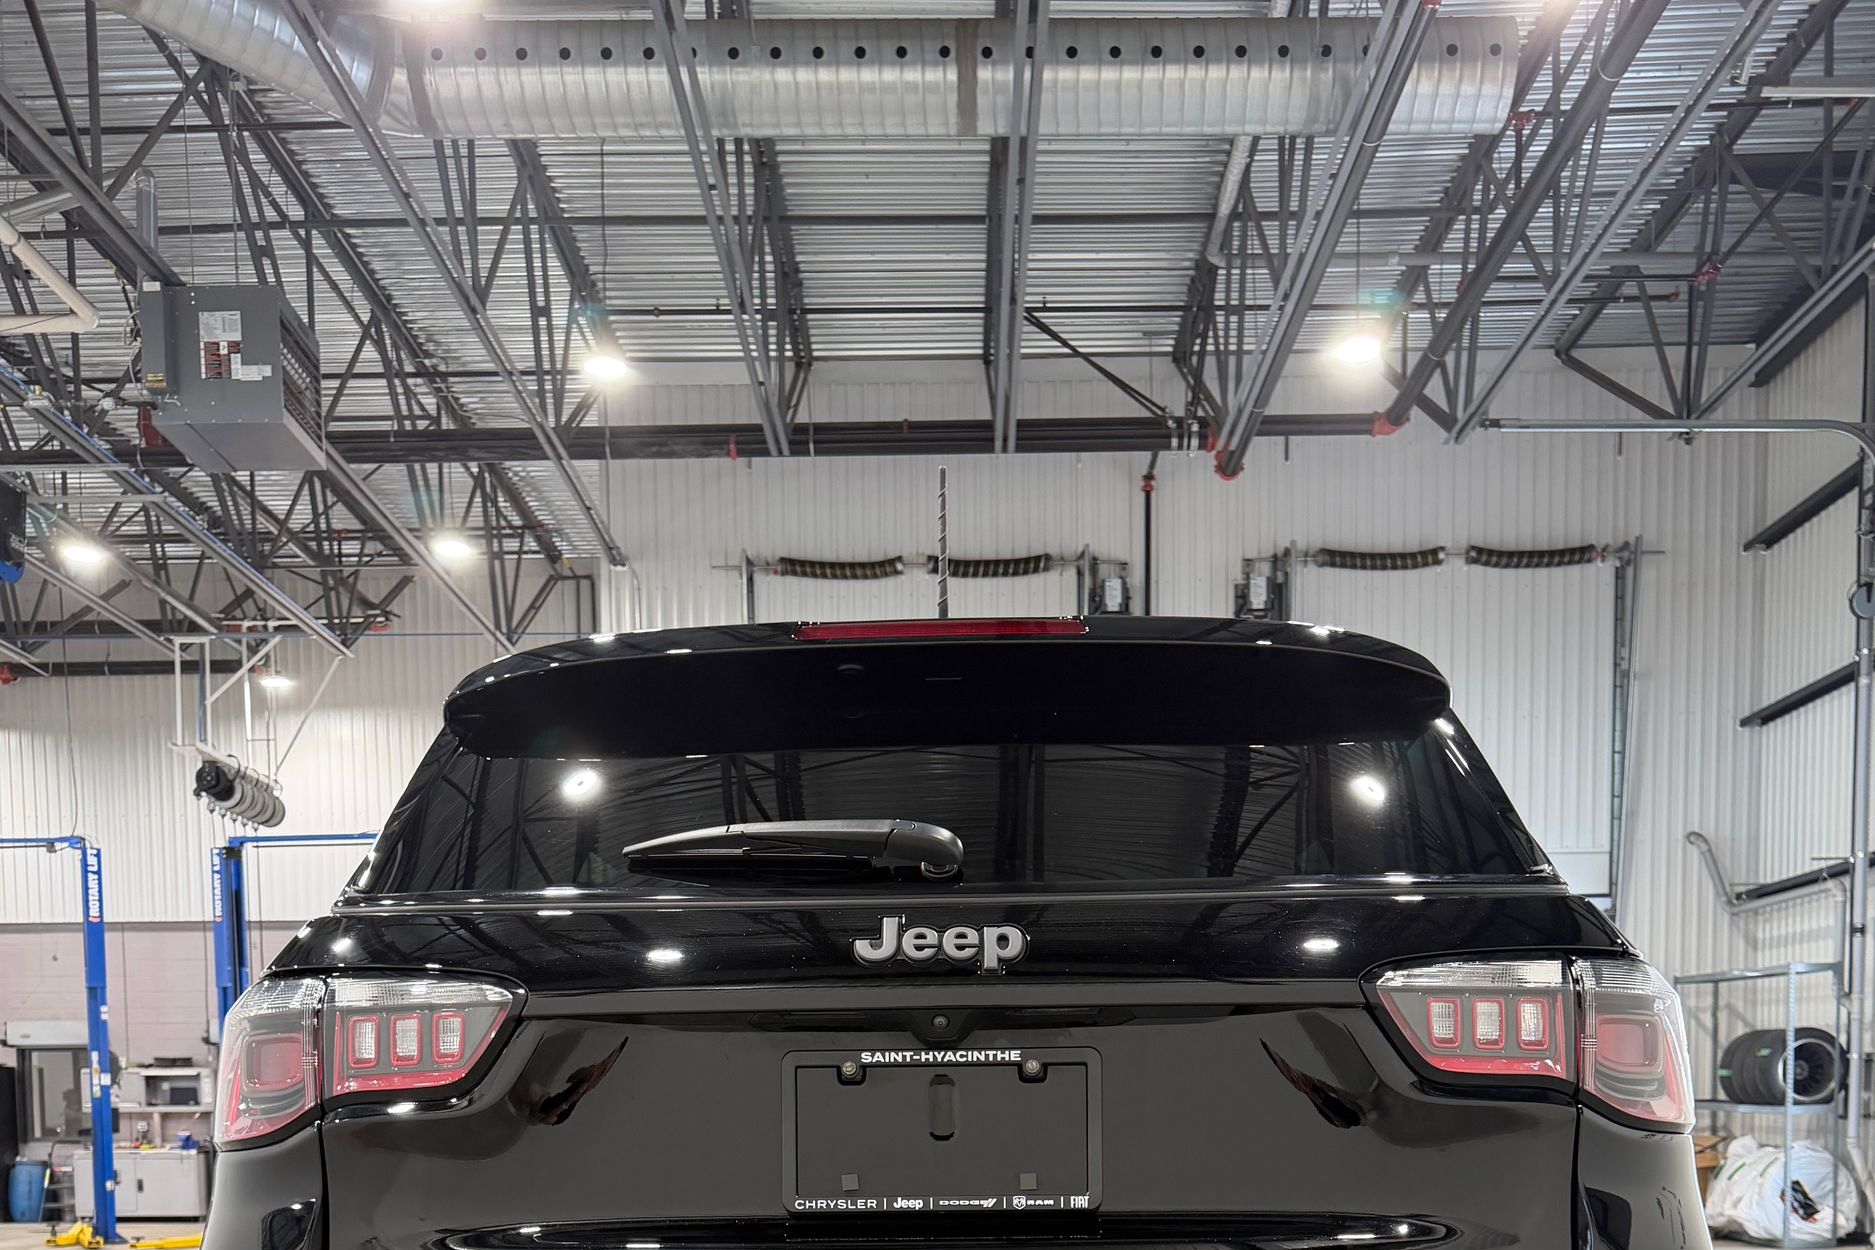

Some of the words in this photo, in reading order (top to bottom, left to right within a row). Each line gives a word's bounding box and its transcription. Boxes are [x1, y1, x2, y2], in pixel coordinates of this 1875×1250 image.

[87, 848, 98, 871] LIFT
[87, 873, 100, 917] ROTARY
[854, 916, 1024, 970] Jeep
[860, 1050, 1021, 1063] SAINT-HYACINTHE
[794, 1199, 877, 1210] CHRYSLER
[893, 1196, 924, 1210] Jeep
[1070, 1195, 1090, 1208] FIAT
